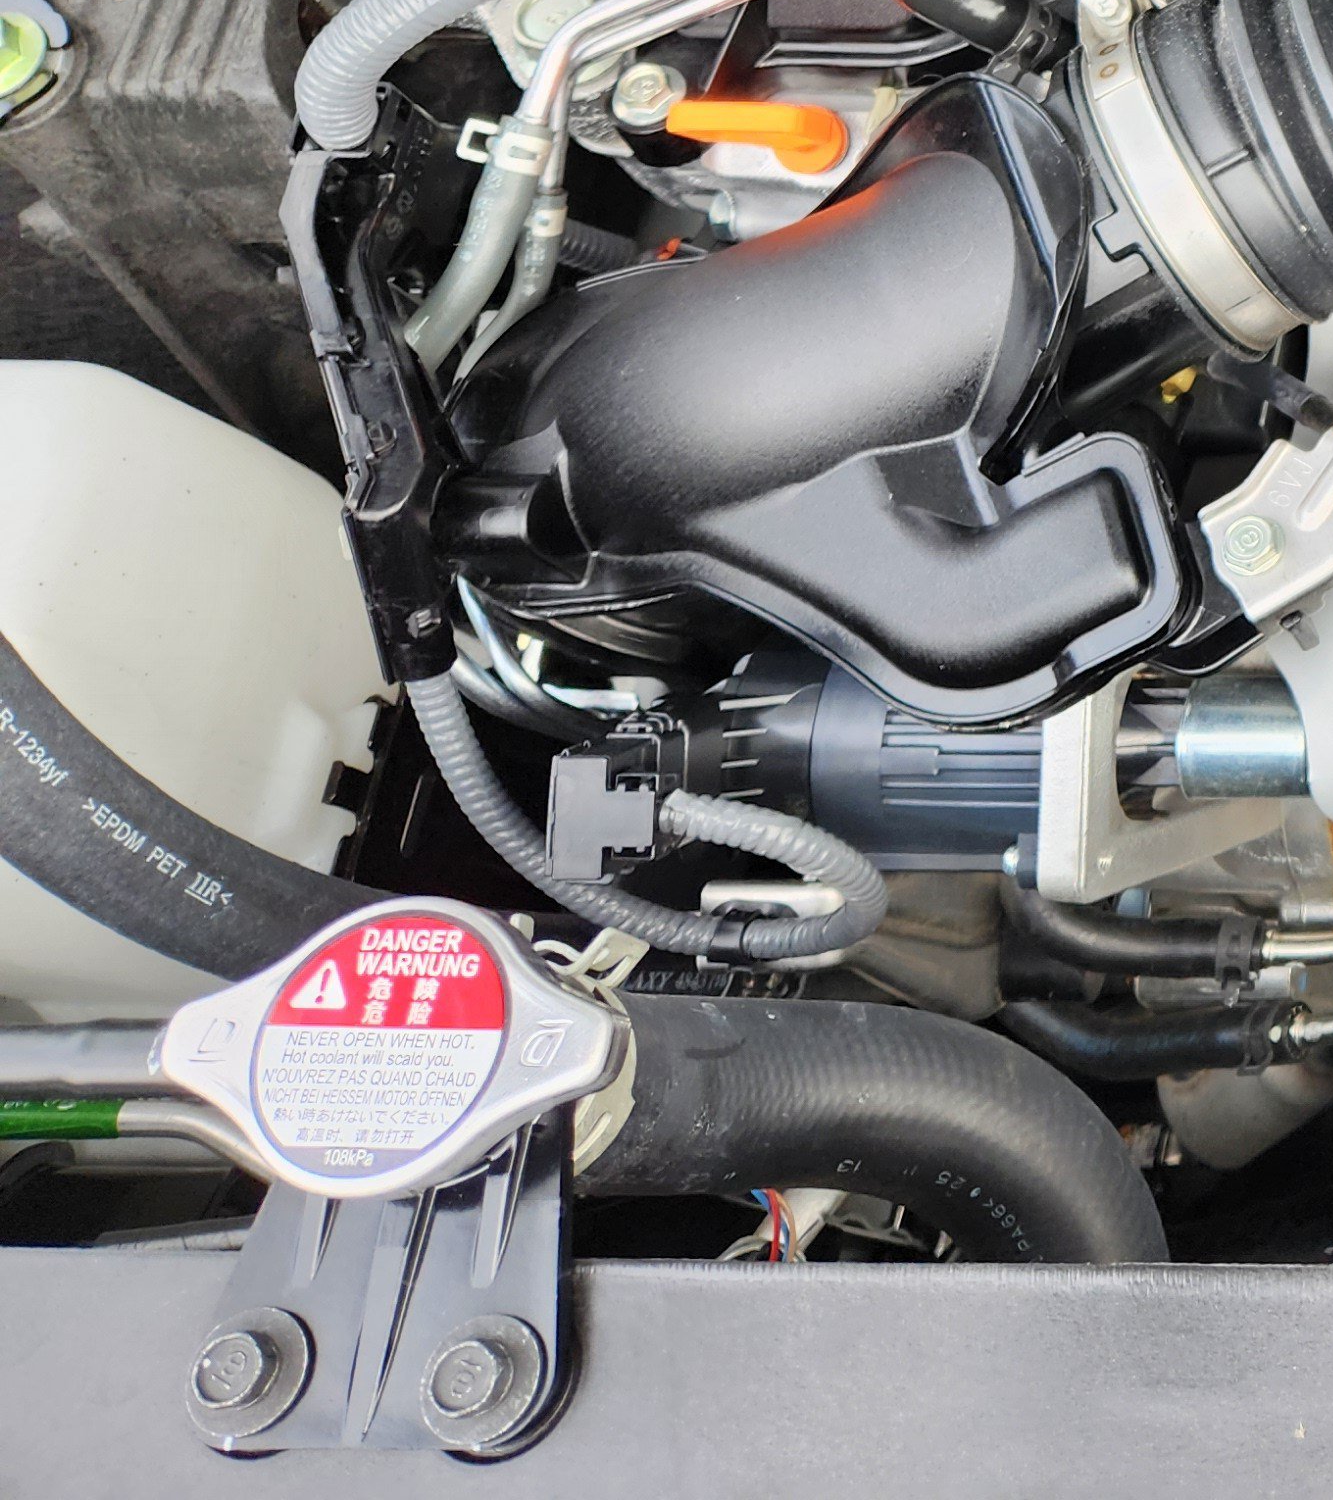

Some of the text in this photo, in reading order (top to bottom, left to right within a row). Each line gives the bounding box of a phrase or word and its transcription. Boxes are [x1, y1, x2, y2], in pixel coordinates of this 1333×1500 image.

[146, 845, 188, 879] PET
[361, 928, 464, 953] DANGER
[356, 952, 481, 978] WARNUNG
[286, 1031, 476, 1050] NEVER OPEN WHEN HOT.
[281, 1048, 454, 1072] Hot coolant will scald you.
[262, 1068, 336, 1084] N'OUVREZ
[338, 1070, 366, 1085] PAS
[370, 1070, 423, 1087] QUAND
[263, 1088, 301, 1104] NICHT
[300, 1089, 322, 1104] BEI
[323, 1089, 372, 1106] HEISSEM
[374, 1090, 417, 1107] MOTOR
[323, 1149, 375, 1167] 108kPa
